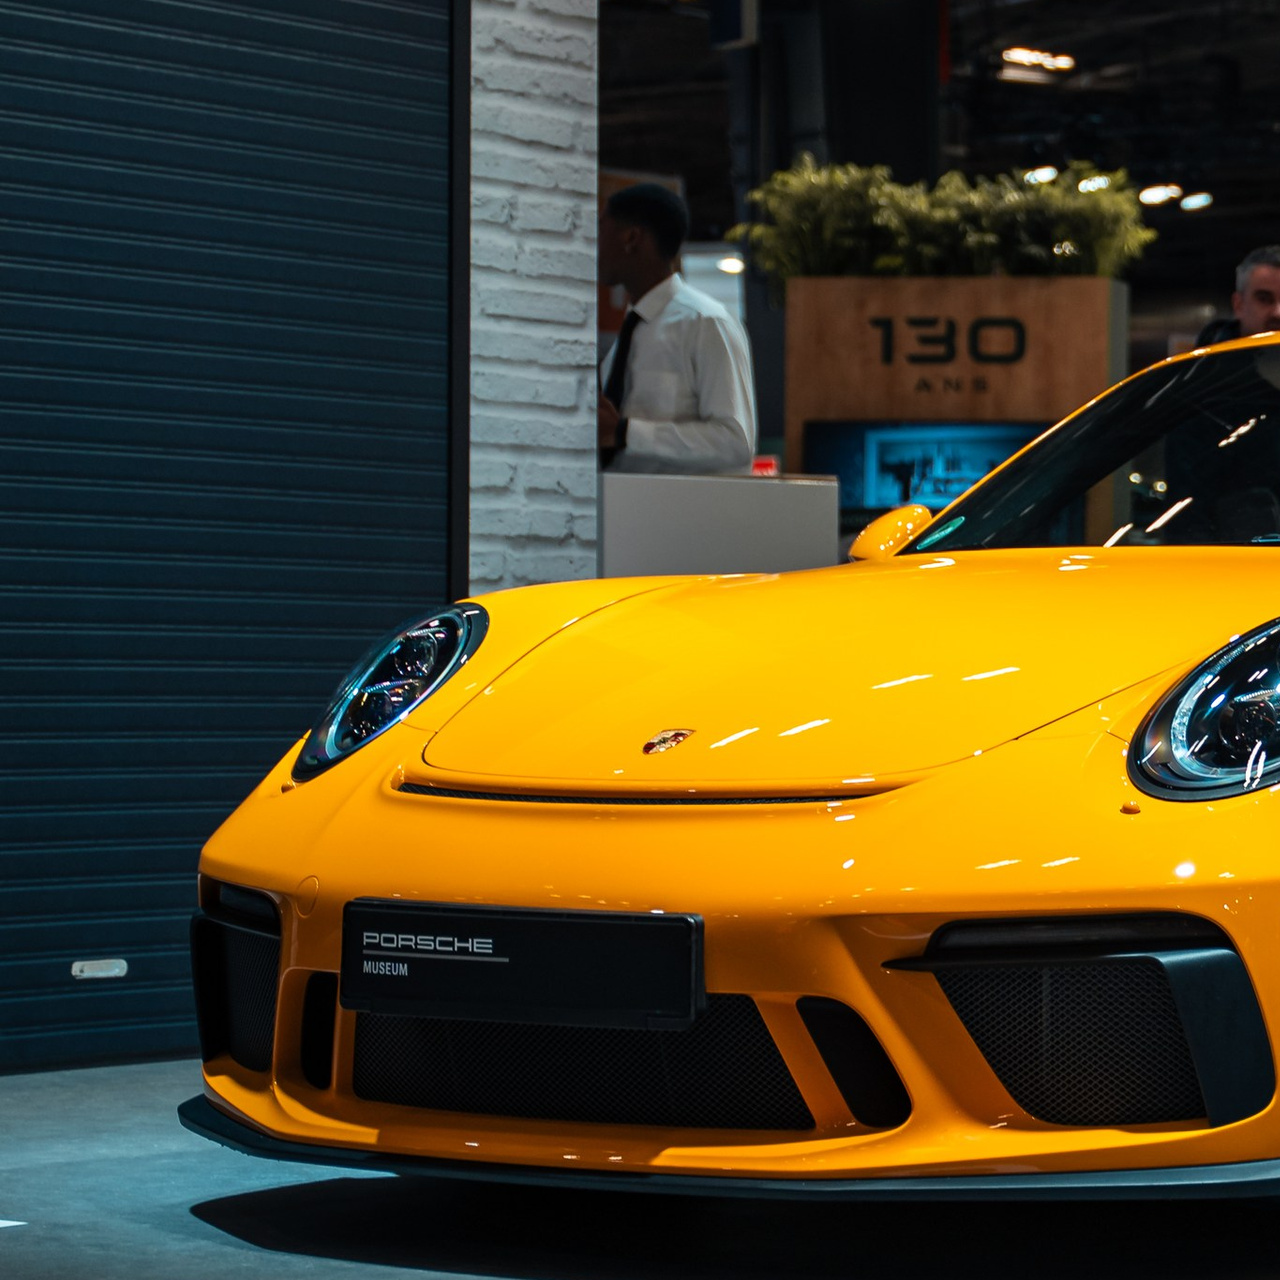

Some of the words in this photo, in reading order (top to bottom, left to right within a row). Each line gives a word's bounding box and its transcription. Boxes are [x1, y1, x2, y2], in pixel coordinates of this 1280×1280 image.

[869, 317, 1027, 365] 130
[914, 376, 988, 393] ANS
[362, 931, 494, 954] PORSCHE
[362, 960, 409, 977] MUSEUM
